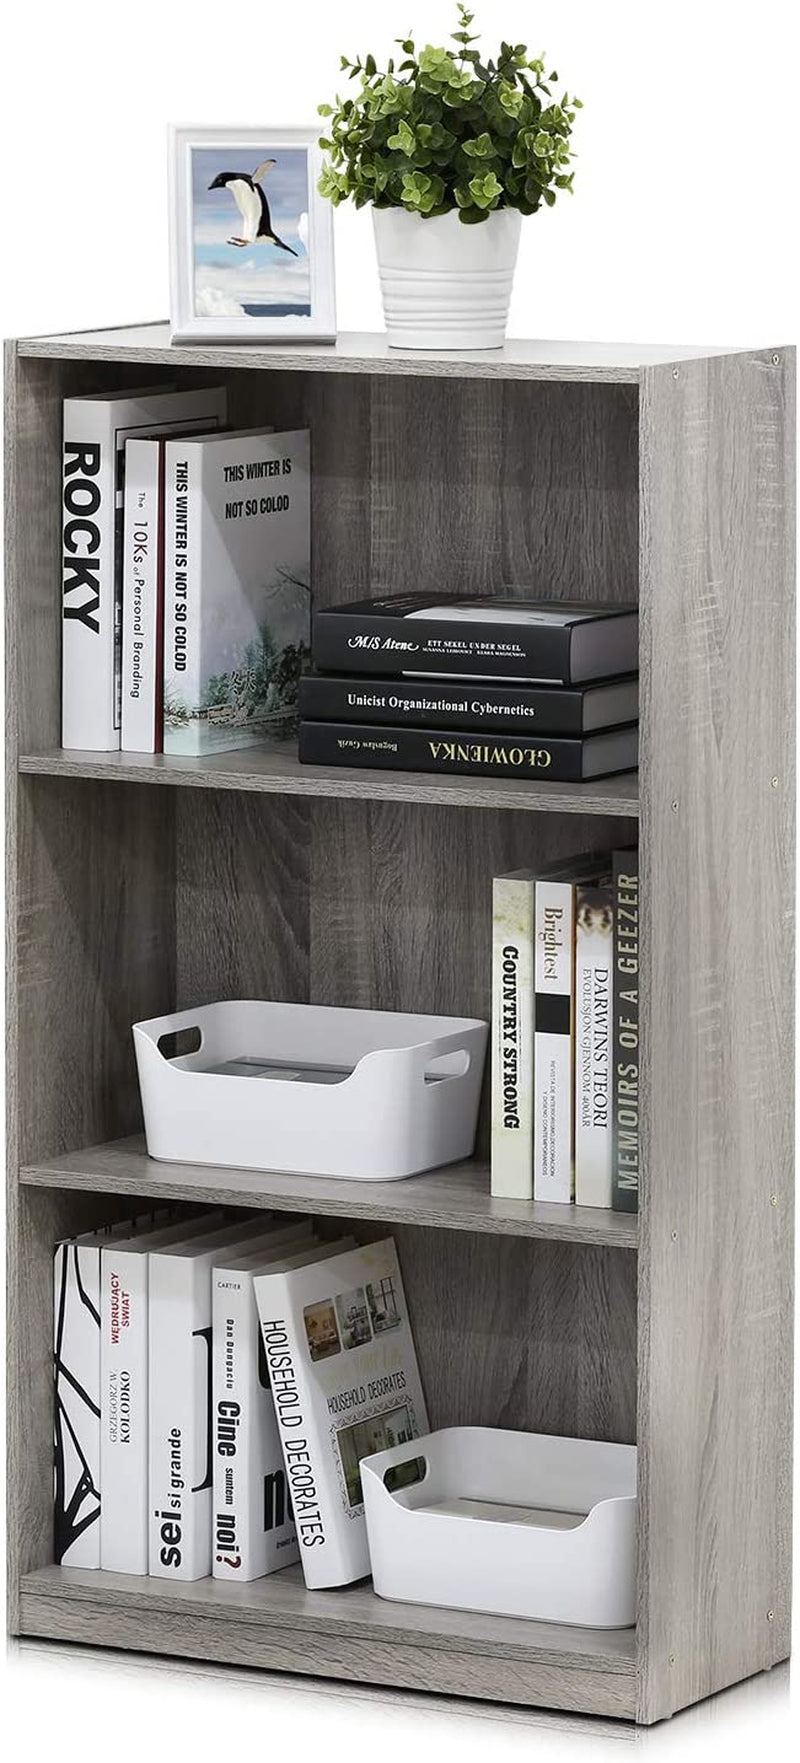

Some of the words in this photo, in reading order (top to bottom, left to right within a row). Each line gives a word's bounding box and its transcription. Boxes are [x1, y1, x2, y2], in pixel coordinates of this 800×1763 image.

[175, 461, 188, 492] THIS
[224, 463, 244, 483] THIS
[246, 460, 280, 479] WINTER
[282, 458, 292, 475] IS
[138, 492, 146, 508] The
[175, 495, 188, 549] WINTER
[225, 502, 244, 519] NOT
[245, 499, 258, 516] SO
[260, 495, 290, 514] COLOD
[63, 441, 101, 635] ROCKY
[133, 521, 148, 563] 10Ks
[174, 553, 188, 568] IS
[133, 579, 145, 636] Personal
[174, 571, 187, 600] NOT
[174, 603, 187, 622] SO
[130, 642, 143, 699] Branding
[174, 625, 187, 672] COLOD
[427, 639, 442, 647] ETT
[443, 641, 468, 649] SEKEL
[469, 642, 496, 650] UNDER
[497, 643, 522, 652] SEGEL
[347, 693, 386, 708] Unicist
[388, 696, 468, 712] Organizational
[470, 701, 535, 716] Cybernetics
[428, 741, 552, 768] GŁOWIENKA
[540, 906, 563, 981] Brightest
[617, 873, 639, 974] GEEZER
[502, 945, 520, 1045] COUNTRY
[581, 968, 592, 1034] EVOLUSJON
[593, 968, 609, 1062] DARWINS
[618, 987, 638, 1005] A
[618, 1015, 639, 1049] OF
[503, 1046, 520, 1129] STRONG
[580, 1036, 592, 1093] GJENNOM
[593, 1068, 608, 1129] TEORI
[617, 1062, 639, 1191] MEMOIRS
[110, 1272, 121, 1345] WĘDRUJĄCY
[120, 1290, 130, 1328] ŚWIAT
[226, 1318, 235, 1338] Dan
[225, 1340, 235, 1390] Dungaciu
[109, 1383, 118, 1443] GRZEGORZ
[326, 1386, 366, 1415] HOUSEHOLD
[367, 1370, 407, 1400] DECORATES
[217, 1400, 241, 1457] Cine
[262, 1319, 303, 1428] HOUSEHOLD
[285, 1440, 325, 1547] DECORATES
[167, 1427, 185, 1489] grande
[224, 1467, 234, 1505] suntem
[154, 1510, 182, 1568] sei
[215, 1513, 242, 1569] noi?
